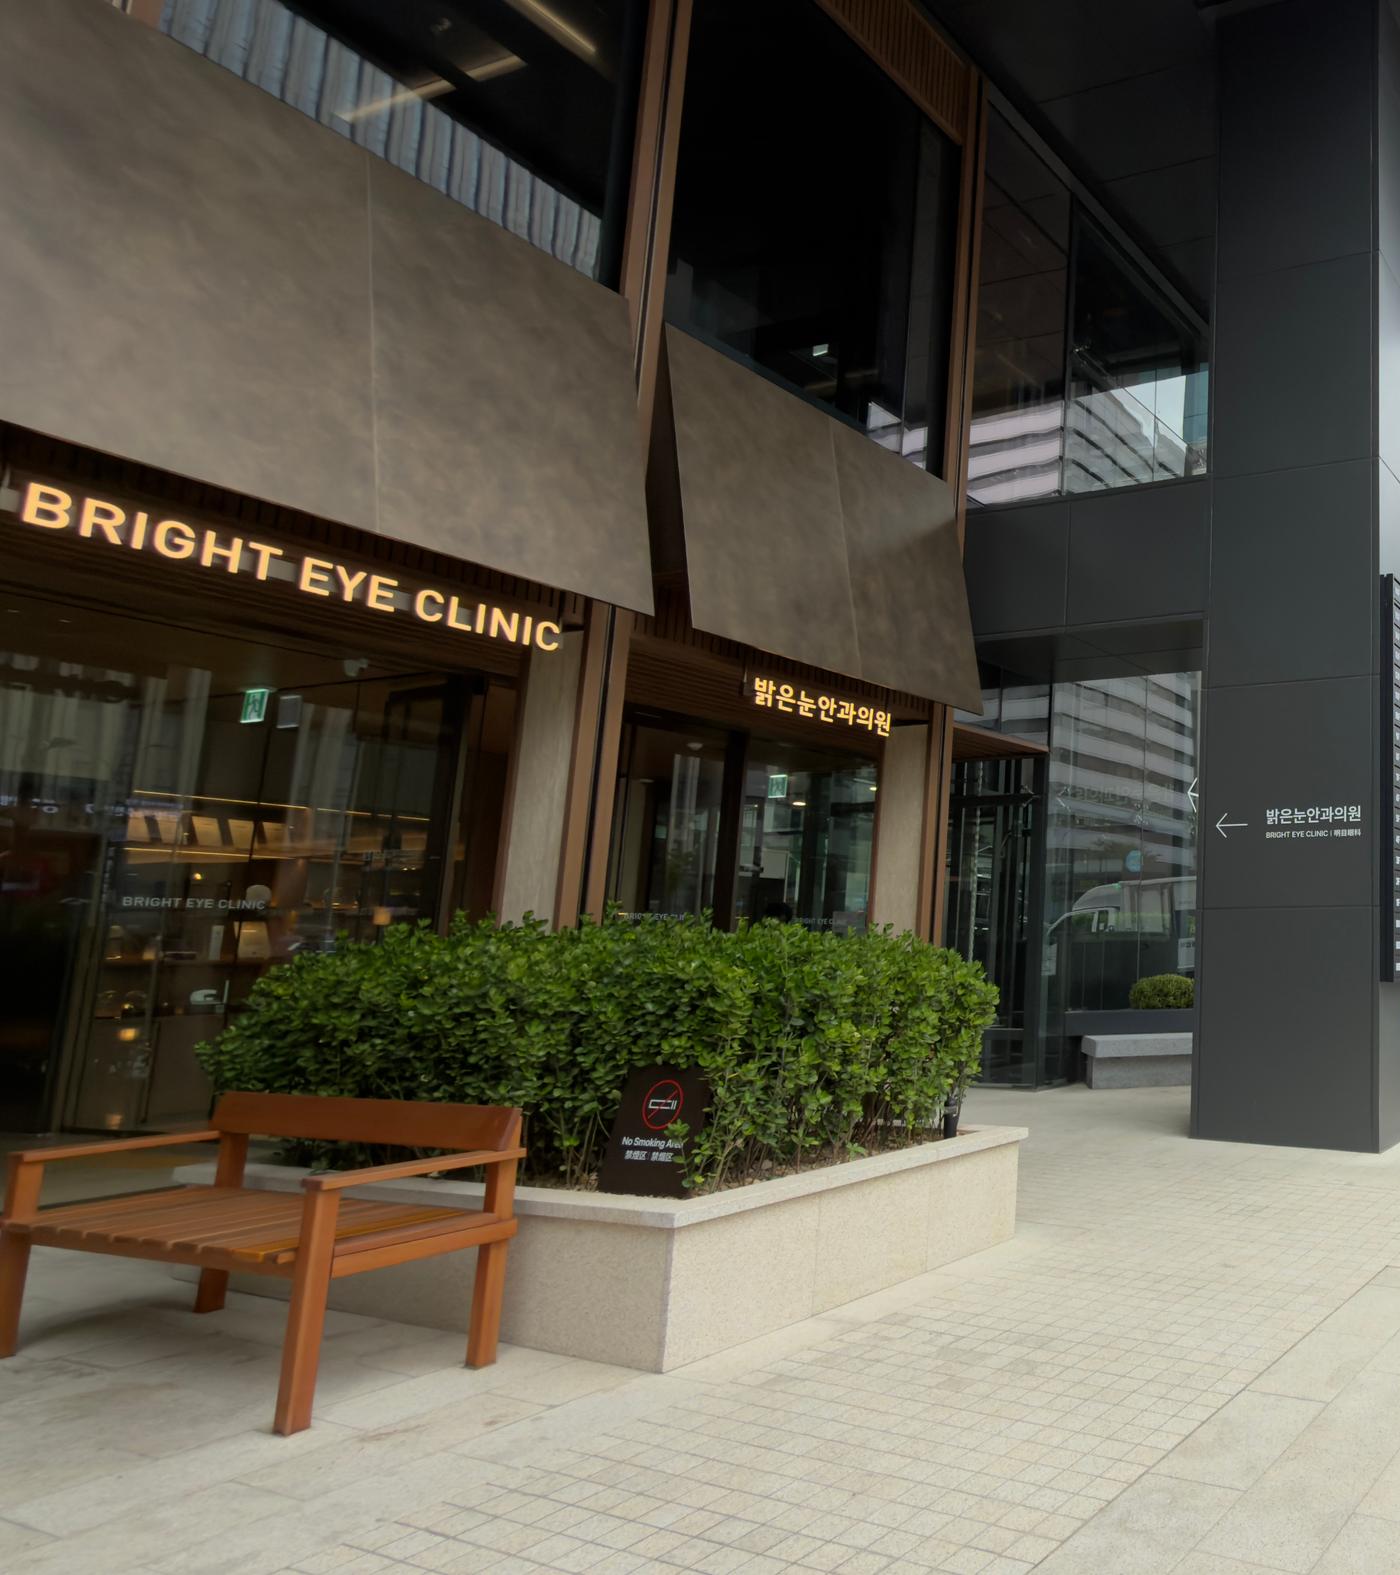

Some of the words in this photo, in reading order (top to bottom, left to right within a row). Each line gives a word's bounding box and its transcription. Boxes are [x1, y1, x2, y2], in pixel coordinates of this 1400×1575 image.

[21, 482, 283, 581] BRIGHT
[299, 555, 399, 612] EYE
[414, 588, 562, 652] CLINIC
[754, 677, 892, 737] 밝은눈안과의원
[1266, 805, 1361, 825] 밝은눈안과의원
[1265, 830, 1290, 839] BRIGHT
[1292, 830, 1305, 838] EYE
[1306, 829, 1328, 838] CLINIC
[122, 896, 182, 907] BRIGHT
[185, 898, 214, 909] EYE
[217, 899, 266, 910] CLINIC
[622, 1136, 633, 1146] No
[634, 1137, 665, 1150] Smoking
